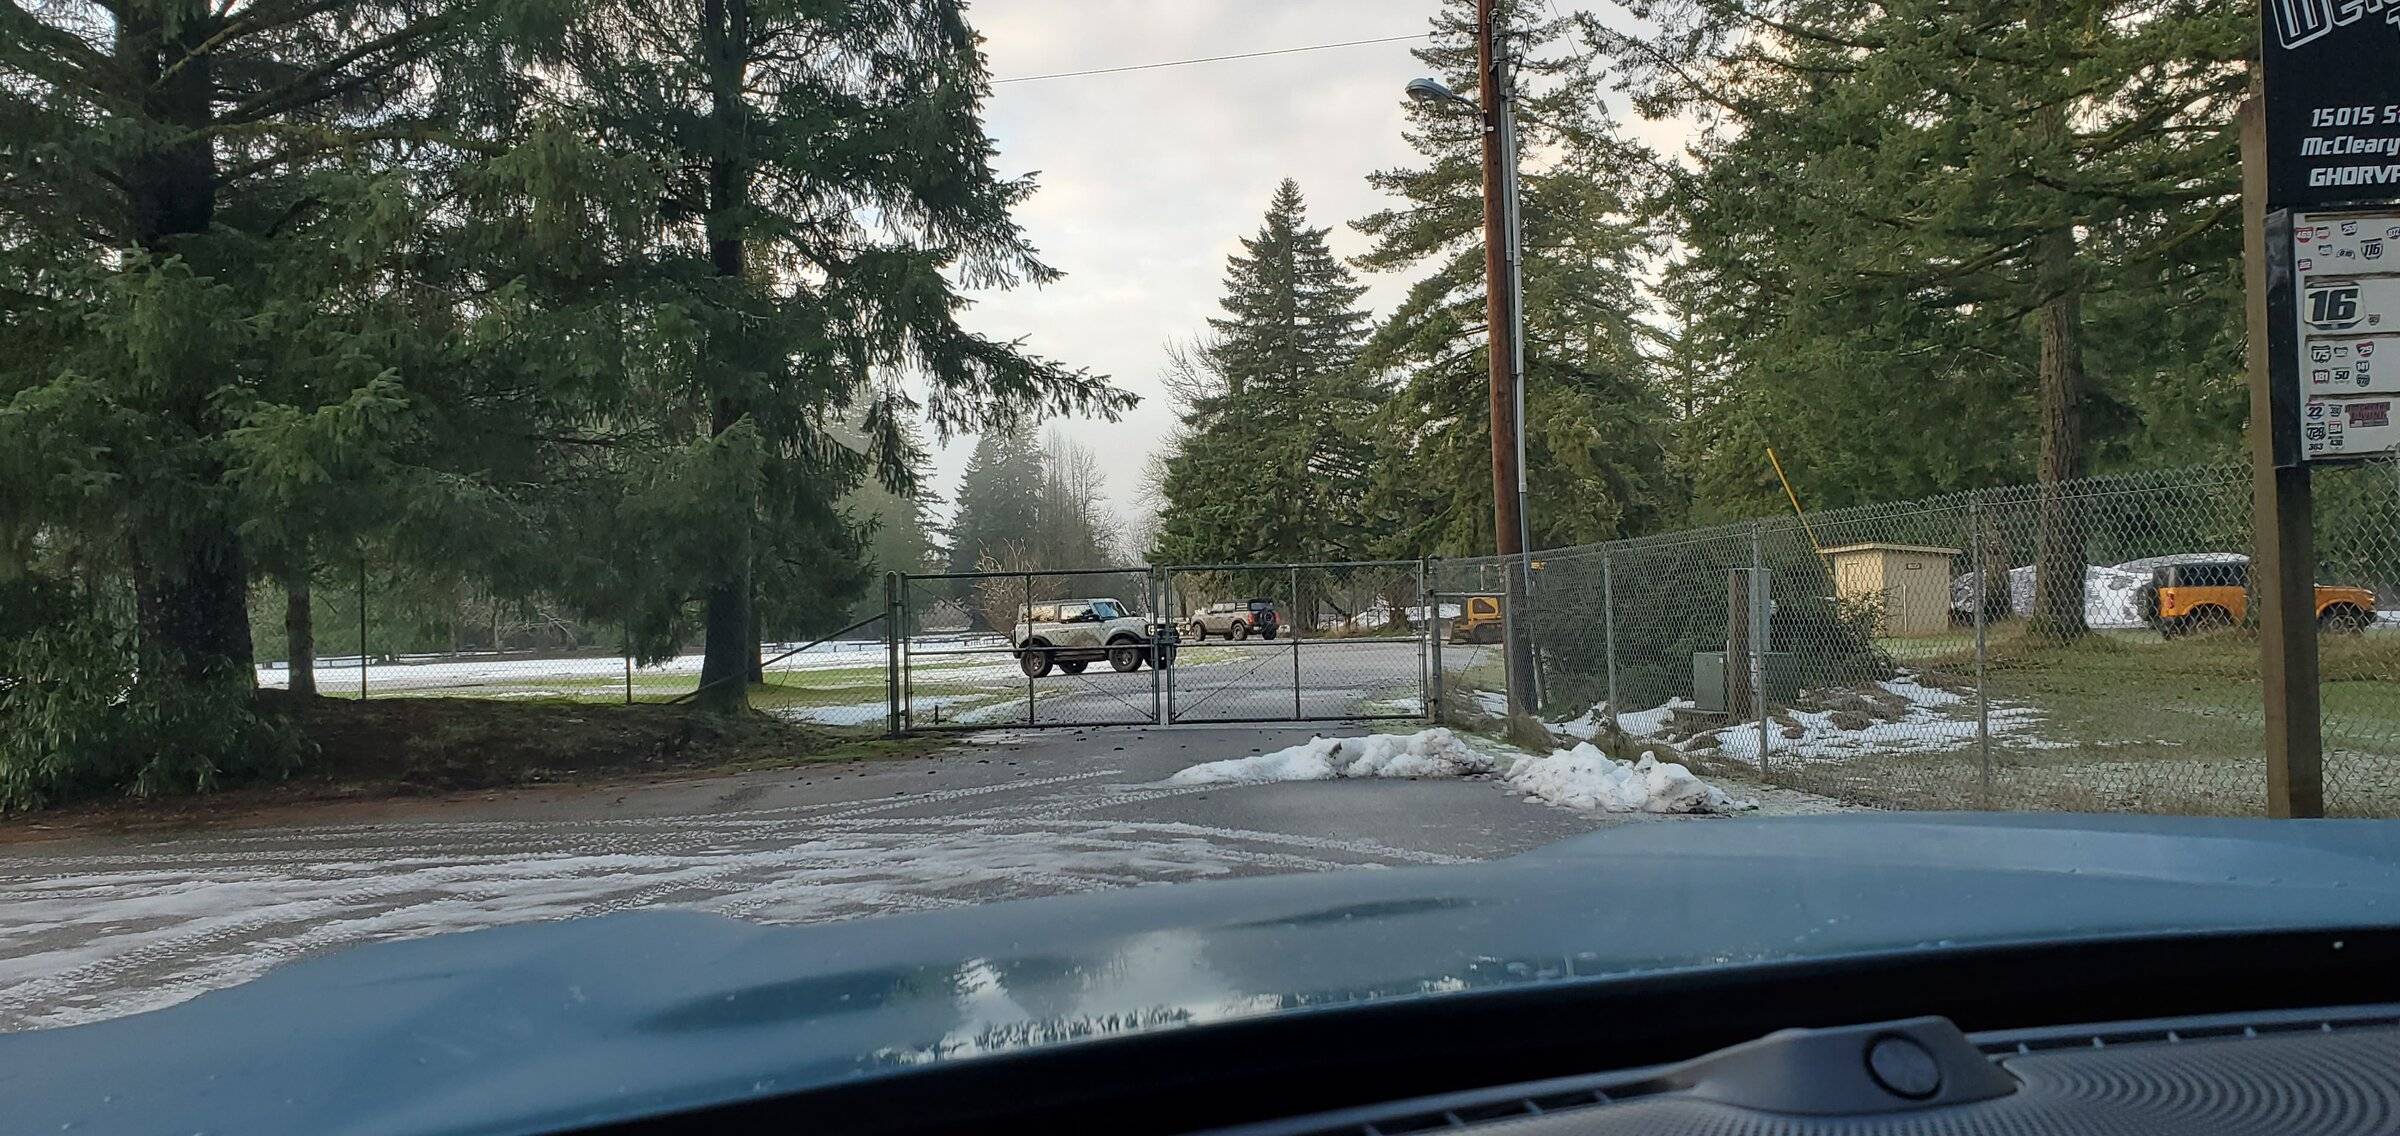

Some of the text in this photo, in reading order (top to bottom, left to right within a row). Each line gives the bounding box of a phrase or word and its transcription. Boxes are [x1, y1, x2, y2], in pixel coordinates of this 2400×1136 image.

[2311, 106, 2375, 127] 15015
[2301, 136, 2400, 156] McCleary
[2308, 289, 2359, 321] 16
[2335, 371, 2350, 380] 50
[2308, 407, 2323, 417] 22
